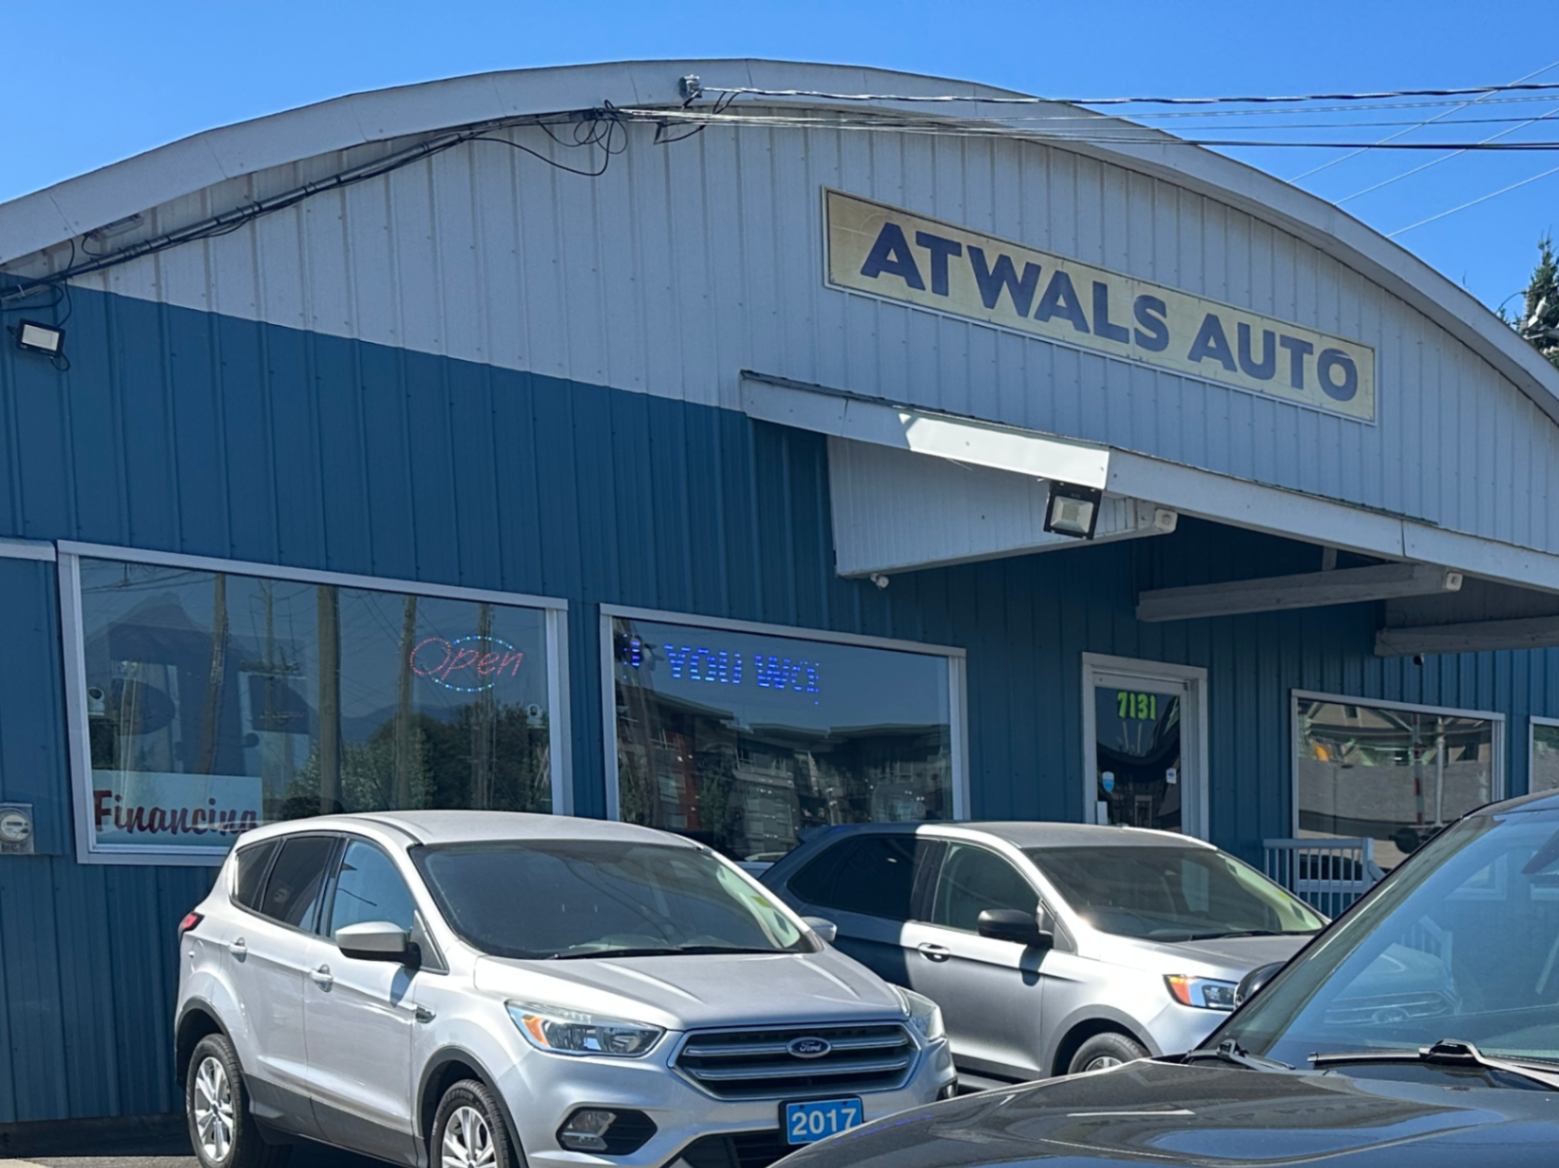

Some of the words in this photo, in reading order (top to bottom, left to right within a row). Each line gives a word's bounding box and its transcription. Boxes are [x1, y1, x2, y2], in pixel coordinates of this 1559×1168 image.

[860, 222, 1170, 352] ATWALS
[1187, 313, 1358, 402] AUTO
[409, 637, 524, 680] Open
[1117, 691, 1157, 721] 7131
[791, 1108, 857, 1136] 2017
